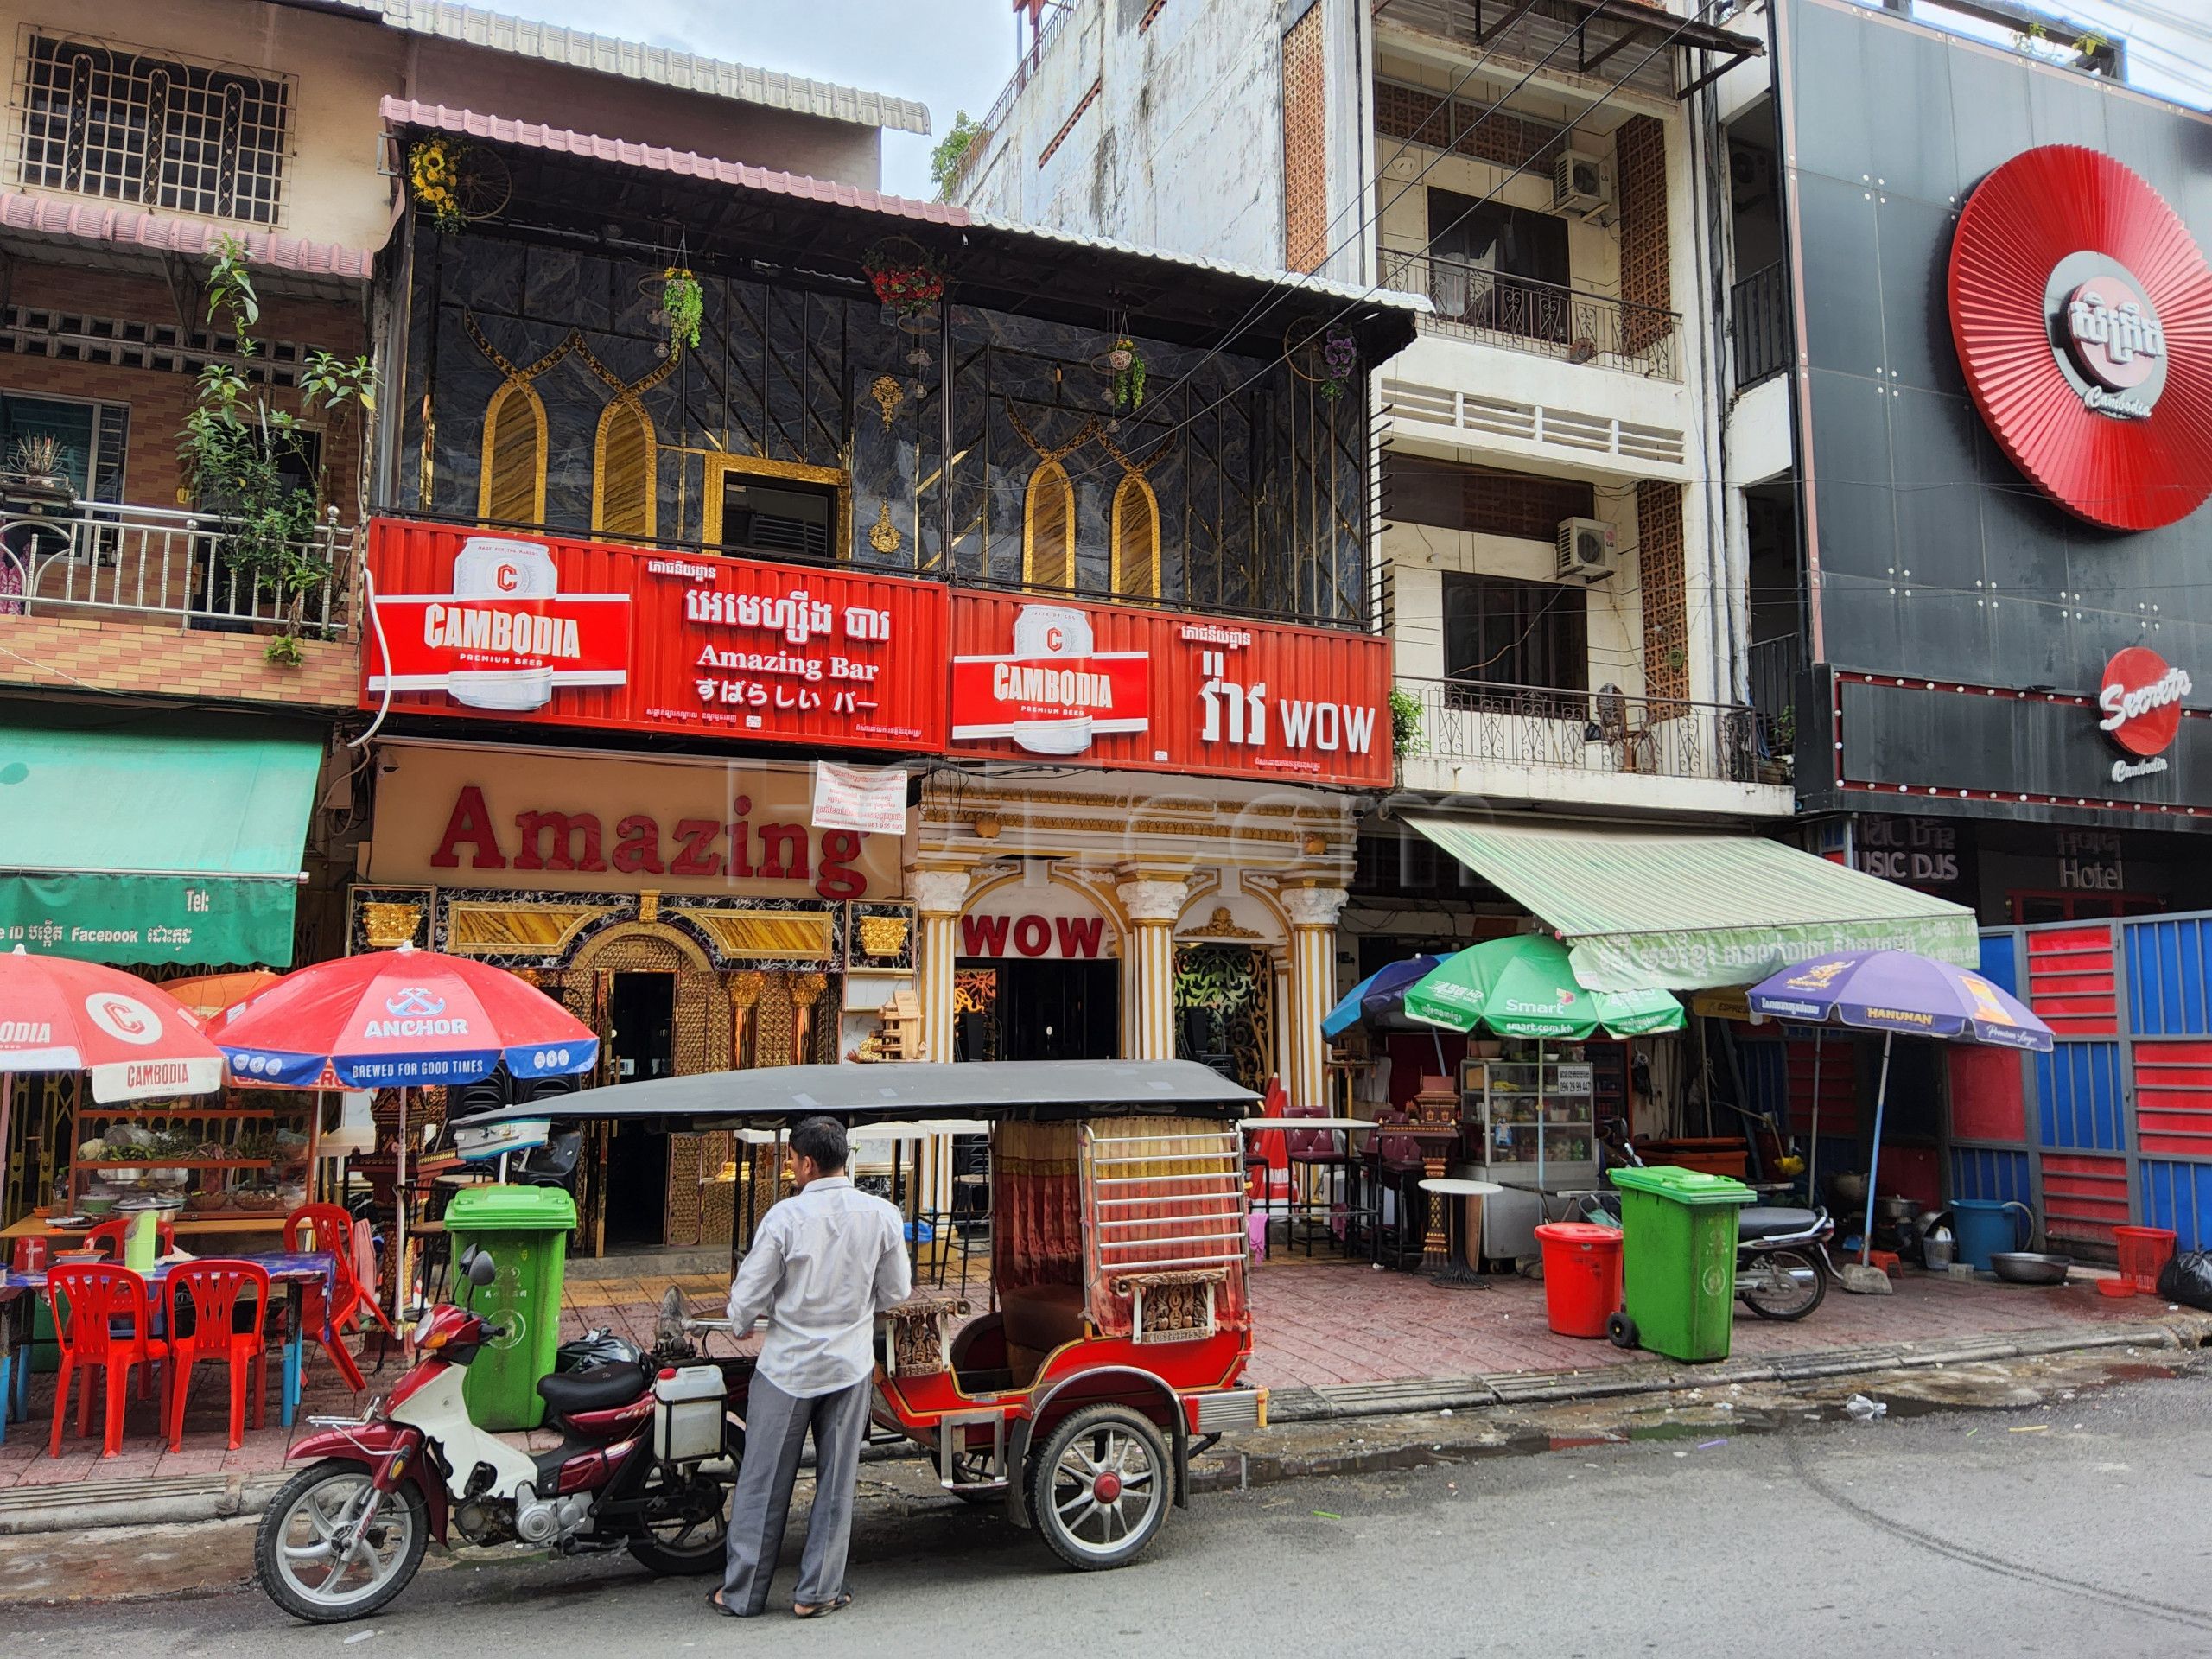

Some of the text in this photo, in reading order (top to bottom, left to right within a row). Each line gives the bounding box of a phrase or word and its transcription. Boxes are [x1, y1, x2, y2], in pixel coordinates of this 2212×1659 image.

[2084, 385, 2153, 418] Cambodia
[423, 603, 581, 658] CAMBODIA
[459, 653, 543, 667] PREMIUM BEER
[696, 645, 879, 681] Amazing Bar
[696, 678, 879, 714] すばらしい バー
[994, 662, 1113, 709] CAMBODIA
[2099, 667, 2193, 731] Secrets
[1020, 705, 1059, 715] PREMIUM
[1280, 698, 1376, 753] WOW
[431, 785, 872, 900] Amazing
[2060, 858, 2125, 891] Hotel
[186, 889, 209, 912] Tel:
[9, 926, 24, 940] ID
[962, 914, 1103, 957] WOW
[1506, 998, 1564, 1014] Smart
[1867, 1007, 1933, 1026] HANUMAN
[364, 1019, 468, 1038] ANCHOR
[1506, 1021, 1574, 1034] smart.com.kh
[127, 1063, 189, 1089] CAMBODIA
[353, 1059, 484, 1079] BREWED FOR GOOD TIMES
